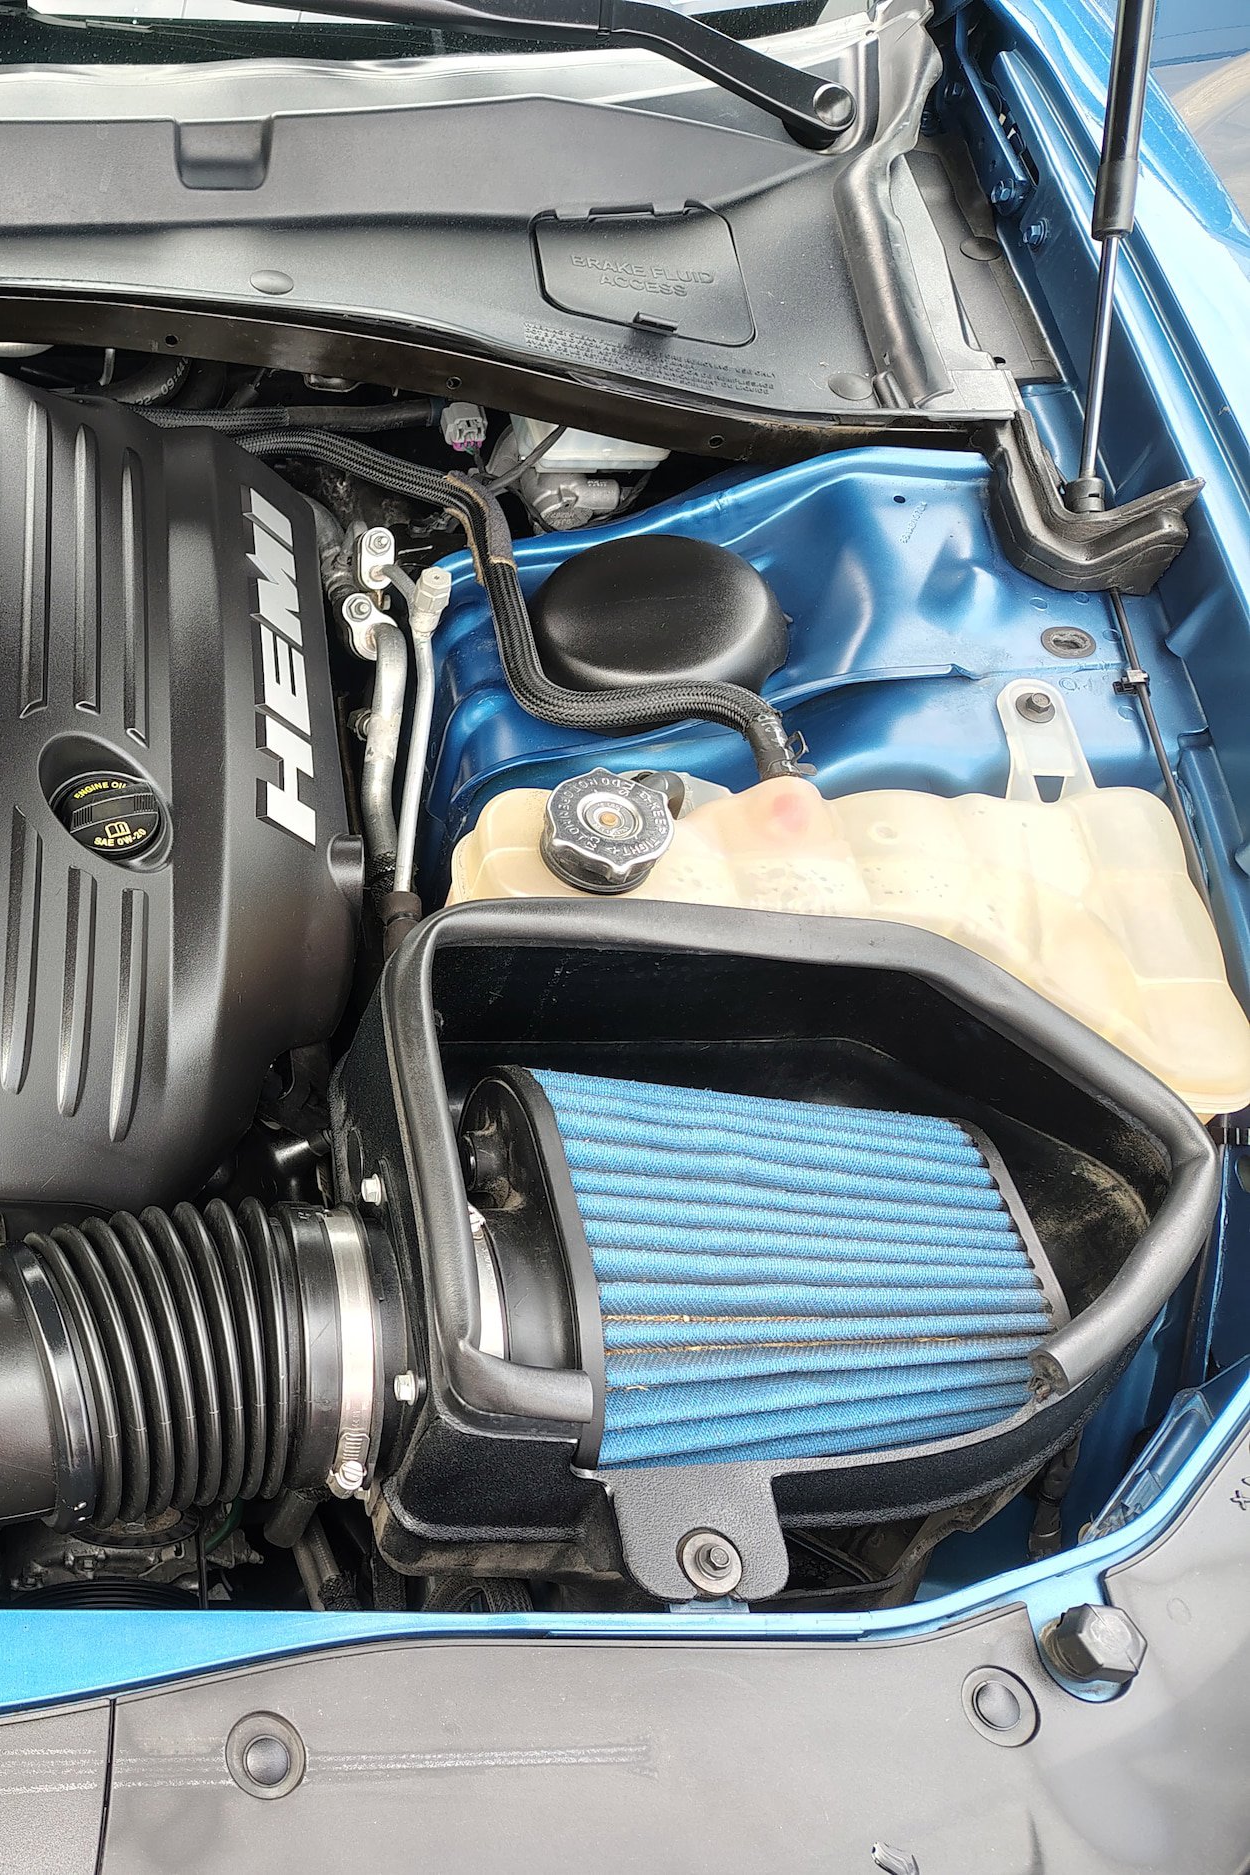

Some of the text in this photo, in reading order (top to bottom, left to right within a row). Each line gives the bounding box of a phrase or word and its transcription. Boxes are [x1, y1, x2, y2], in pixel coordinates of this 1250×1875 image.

[570, 253, 715, 284] BRAKE FLUID
[600, 275, 688, 297] ACCESS
[246, 487, 316, 846] HEMI
[74, 781, 109, 800] ENGINE
[94, 828, 147, 846] SAE 0W-20
[623, 838, 660, 856] TIGHT
